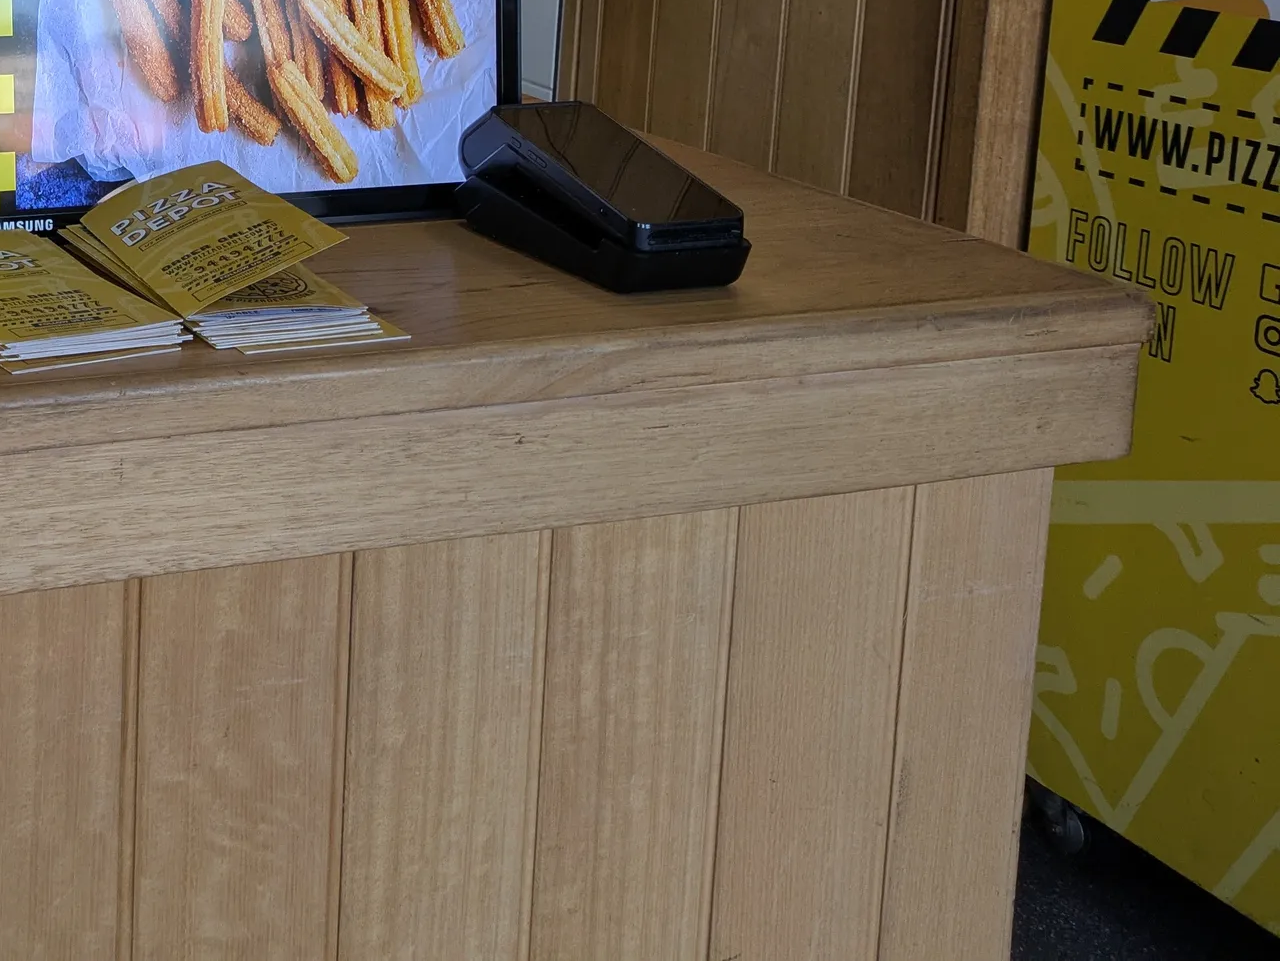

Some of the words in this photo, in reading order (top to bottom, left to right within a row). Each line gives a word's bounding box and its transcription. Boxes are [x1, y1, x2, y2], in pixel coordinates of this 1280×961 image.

[1094, 105, 1280, 192] WWW.PIZZ
[110, 181, 233, 236] PIZZA
[122, 190, 241, 247] DEPOT
[161, 244, 211, 272] ORDER
[1066, 208, 1235, 311] FOLLOW
